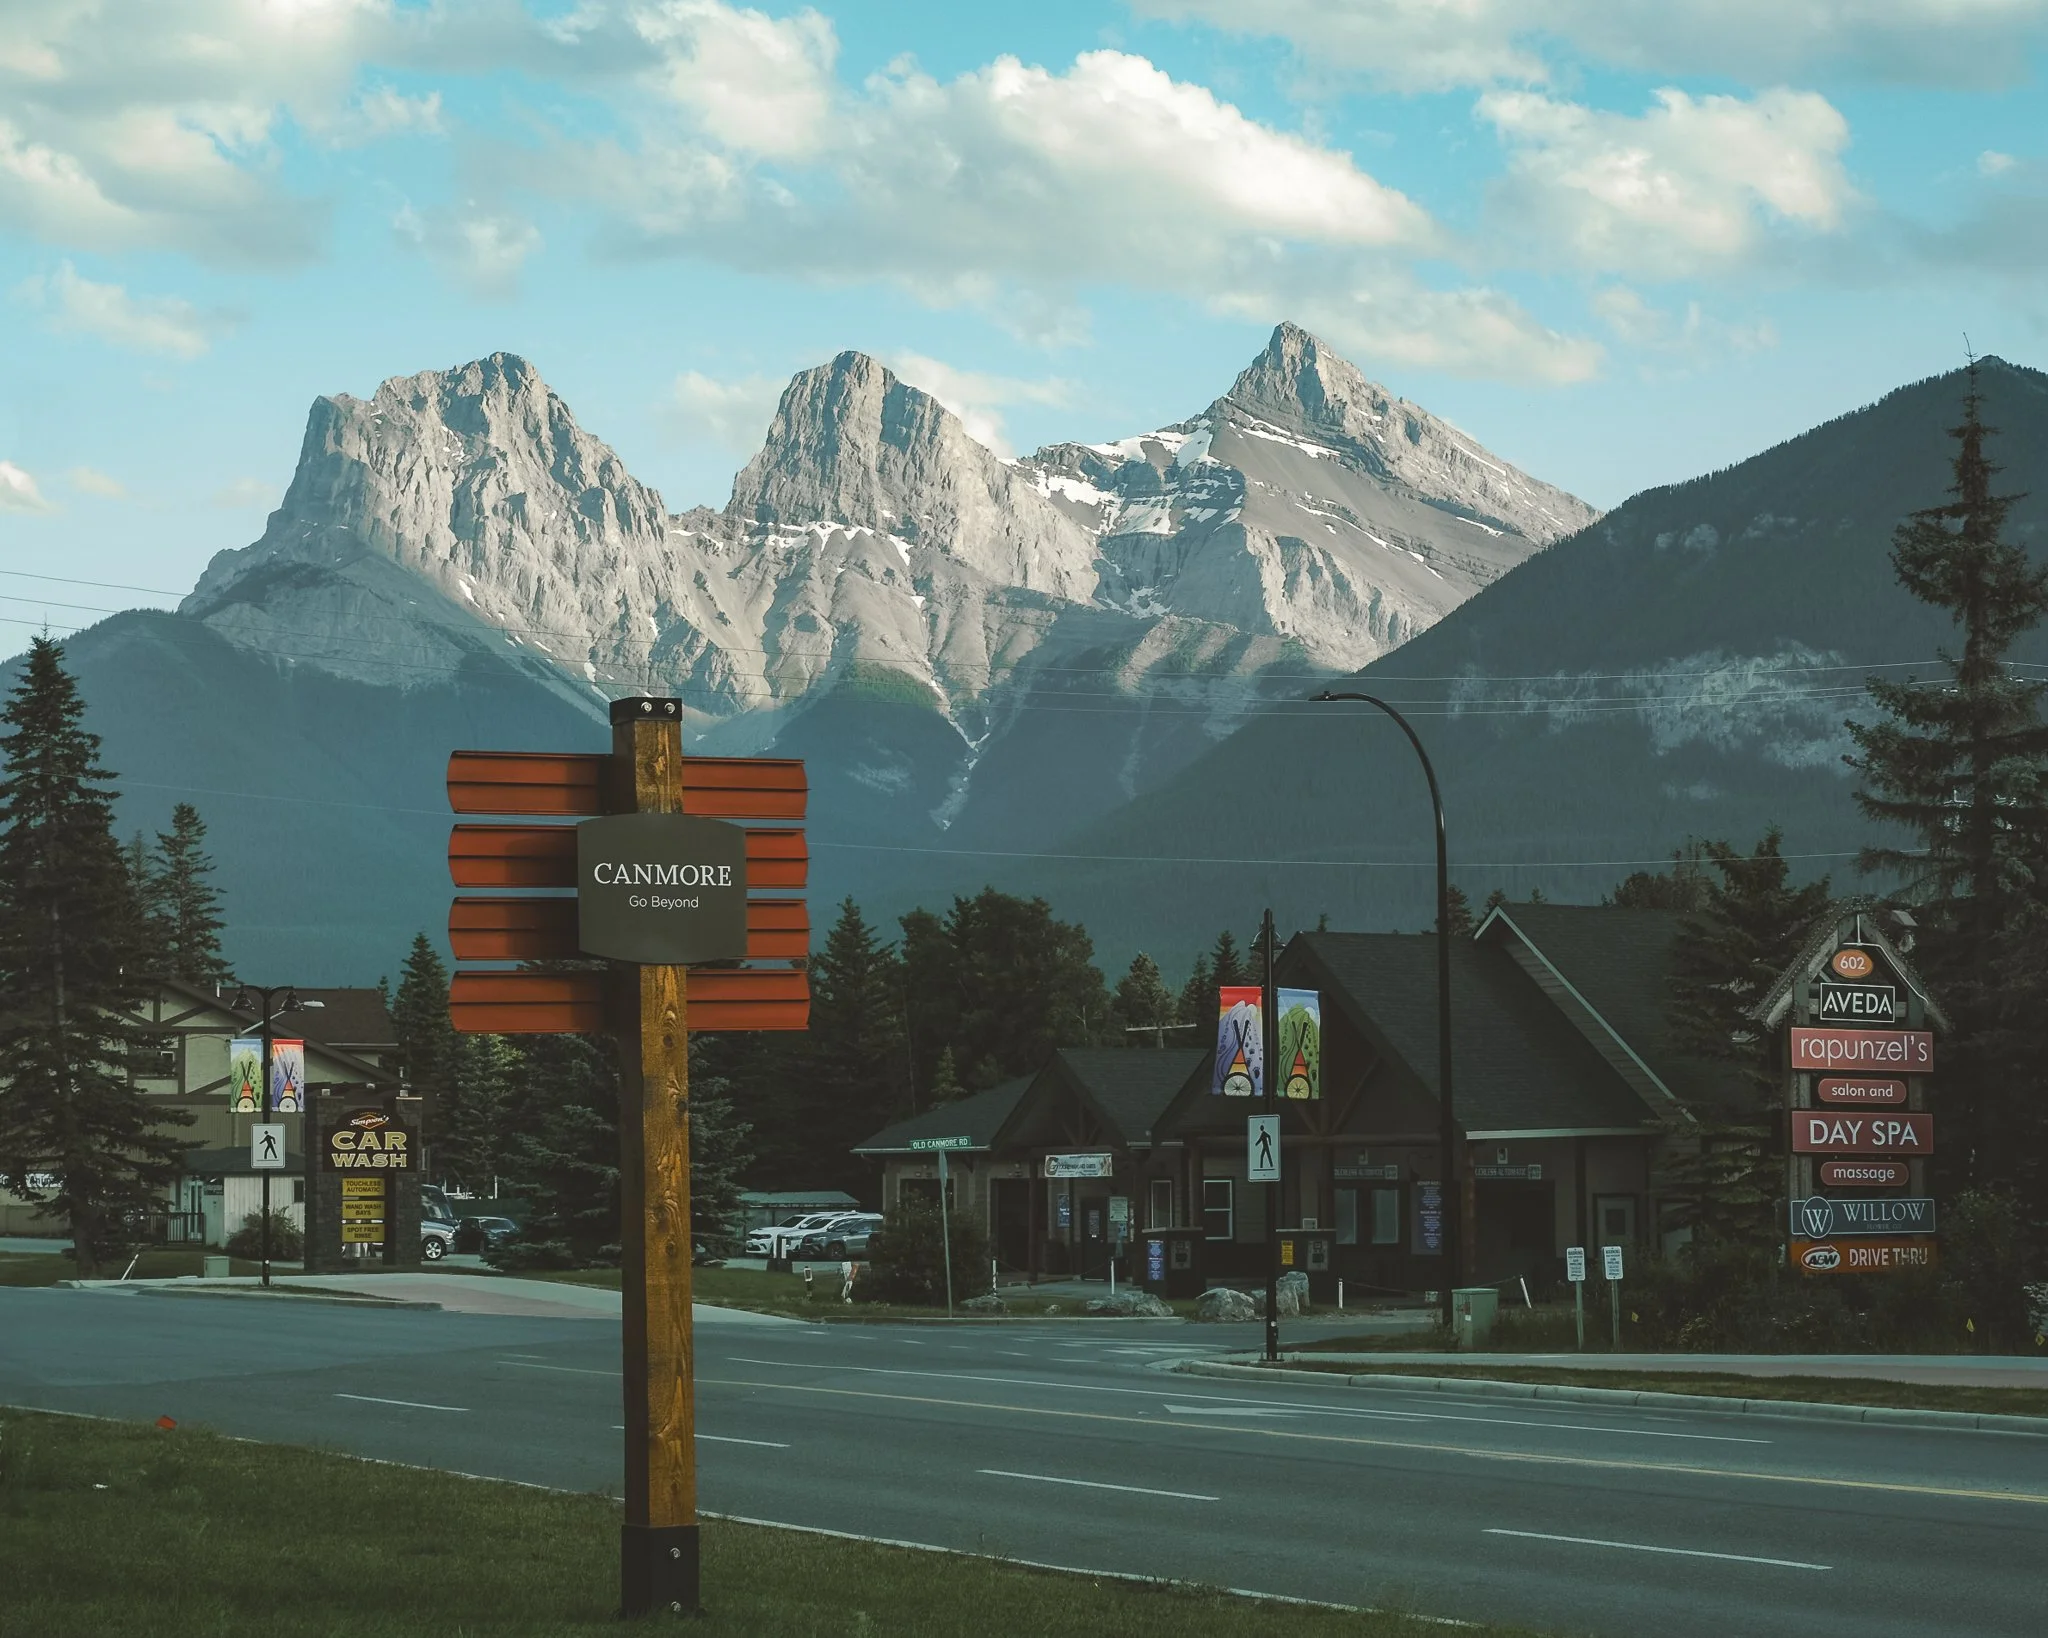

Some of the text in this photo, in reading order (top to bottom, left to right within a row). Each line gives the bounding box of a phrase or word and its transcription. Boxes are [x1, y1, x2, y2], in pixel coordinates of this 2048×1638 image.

[594, 862, 732, 887] CANMORE
[629, 895, 699, 910] Go Beyond
[1840, 956, 1865, 970] 602
[1822, 991, 1892, 1015] AVEDA
[1800, 1035, 1928, 1066] rapunzel's
[1831, 1083, 1893, 1098] salon and
[331, 1130, 407, 1151] CAR
[1809, 1119, 1918, 1146] DAY SPA
[913, 1138, 968, 1150] OLD CANMORE RD
[331, 1153, 407, 1168] WASH
[1833, 1167, 1895, 1182] massage
[1805, 1202, 1926, 1233] W WILLOW
[1808, 1247, 1928, 1266] A&W DRIVE THRU
